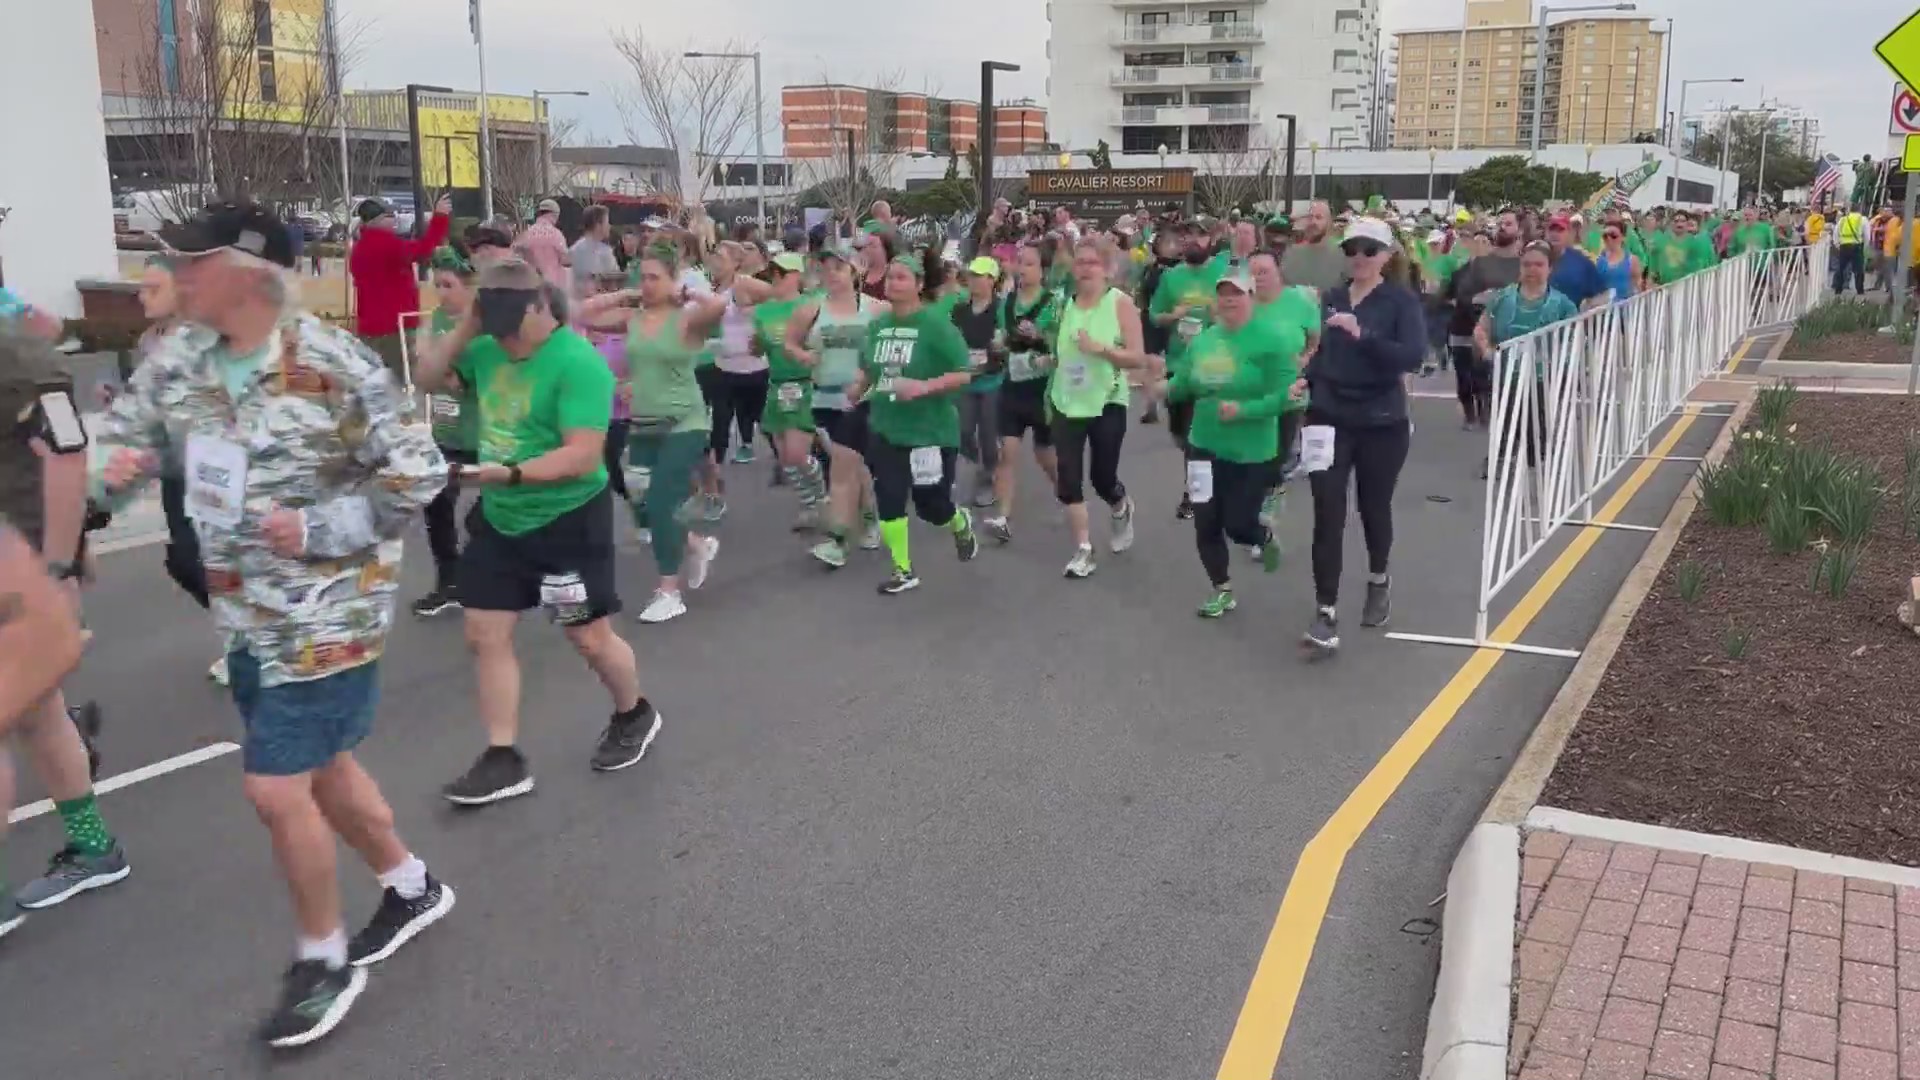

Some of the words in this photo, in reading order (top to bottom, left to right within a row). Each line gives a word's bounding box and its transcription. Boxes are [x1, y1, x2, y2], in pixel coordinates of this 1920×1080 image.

[1048, 176, 1109, 189] CAVALIER
[1112, 175, 1164, 188] RESORT
[735, 215, 773, 225] COMIG
